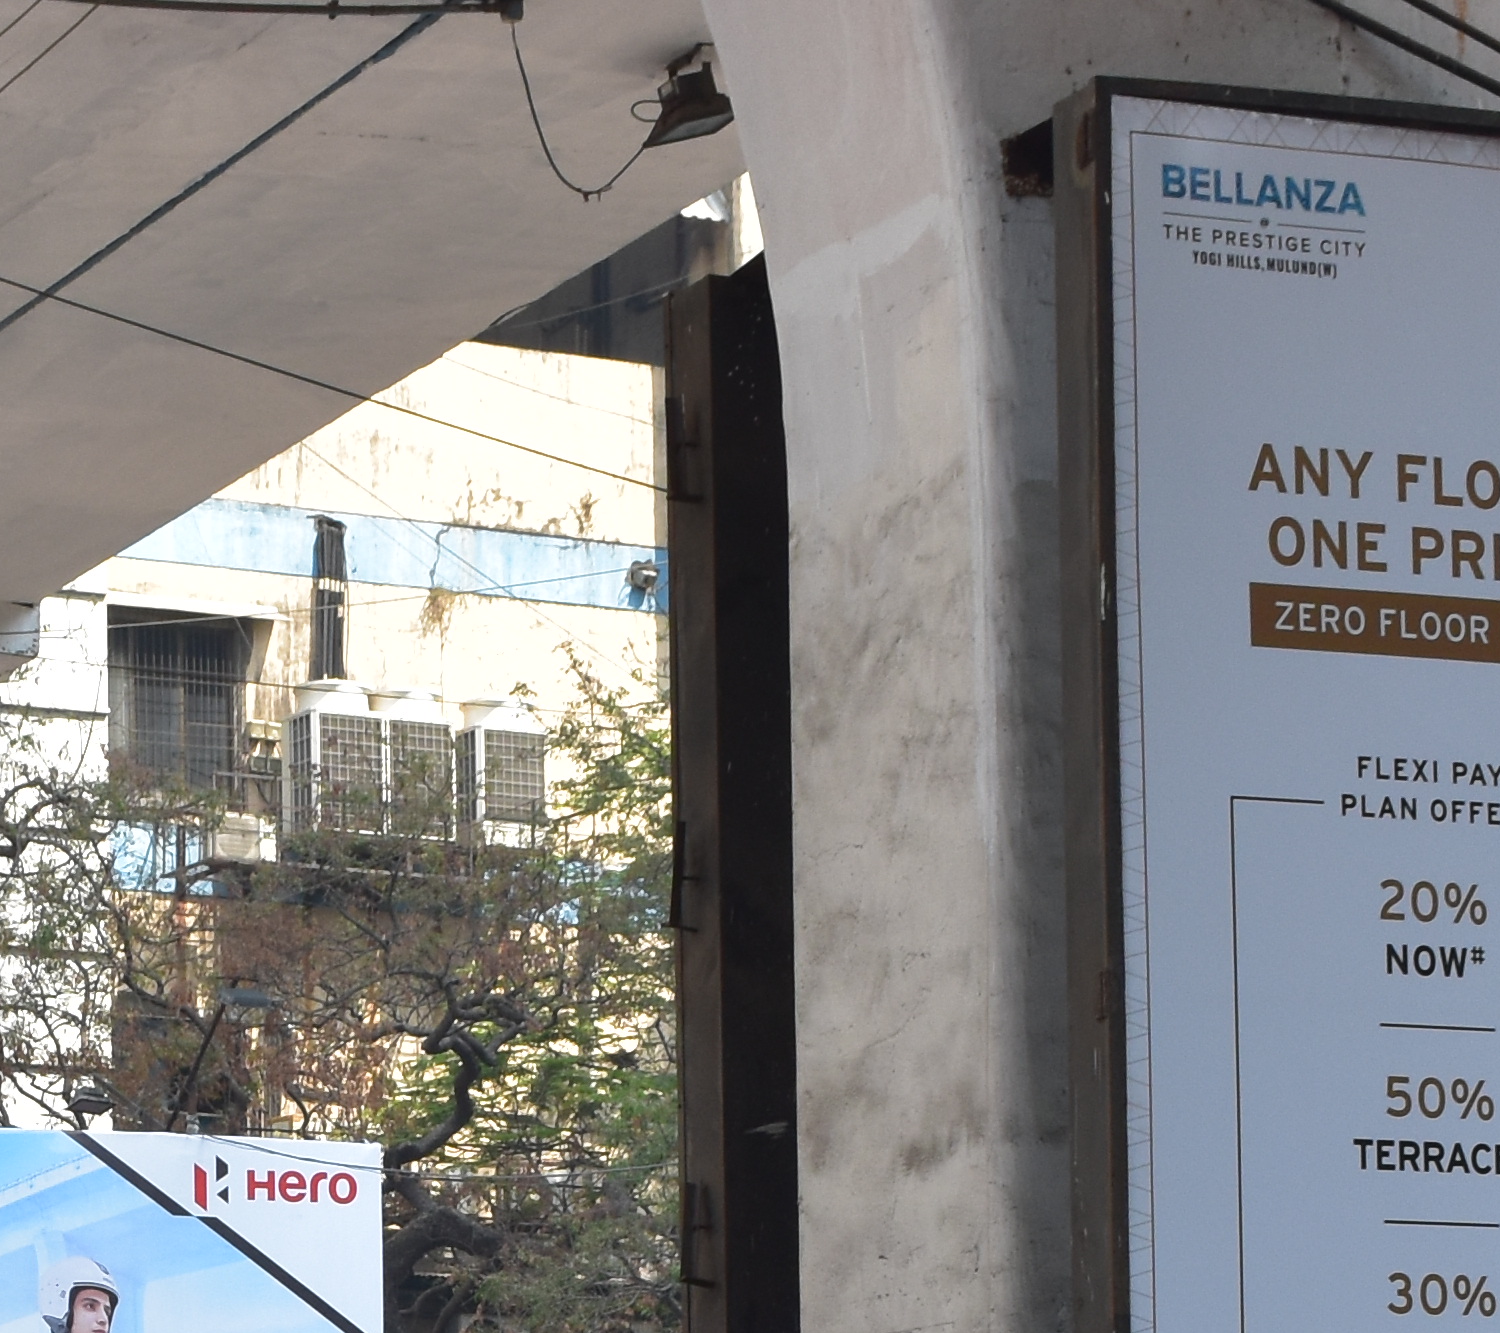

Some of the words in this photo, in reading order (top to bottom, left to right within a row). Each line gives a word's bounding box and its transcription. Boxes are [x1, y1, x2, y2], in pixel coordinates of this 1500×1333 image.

[1162, 164, 1365, 220] BELLANZA
[1163, 224, 1201, 242] THE
[1212, 228, 1310, 254] PRESTIGE
[1320, 240, 1365, 257] CITY
[1193, 251, 1221, 266] YOGI
[1248, 443, 1373, 498] ANY
[1269, 516, 1387, 572] ONE
[1276, 602, 1365, 634] ZERO
[1380, 609, 1489, 643] FLOOR
[1358, 756, 1437, 783] FLEXI
[1342, 794, 1416, 820] PLAN
[1380, 879, 1487, 925] 20%
[1387, 944, 1485, 977] NOW#
[1387, 1076, 1494, 1120] 50%
[247, 1170, 357, 1204] Hero
[1388, 1273, 1496, 1316] 30%
